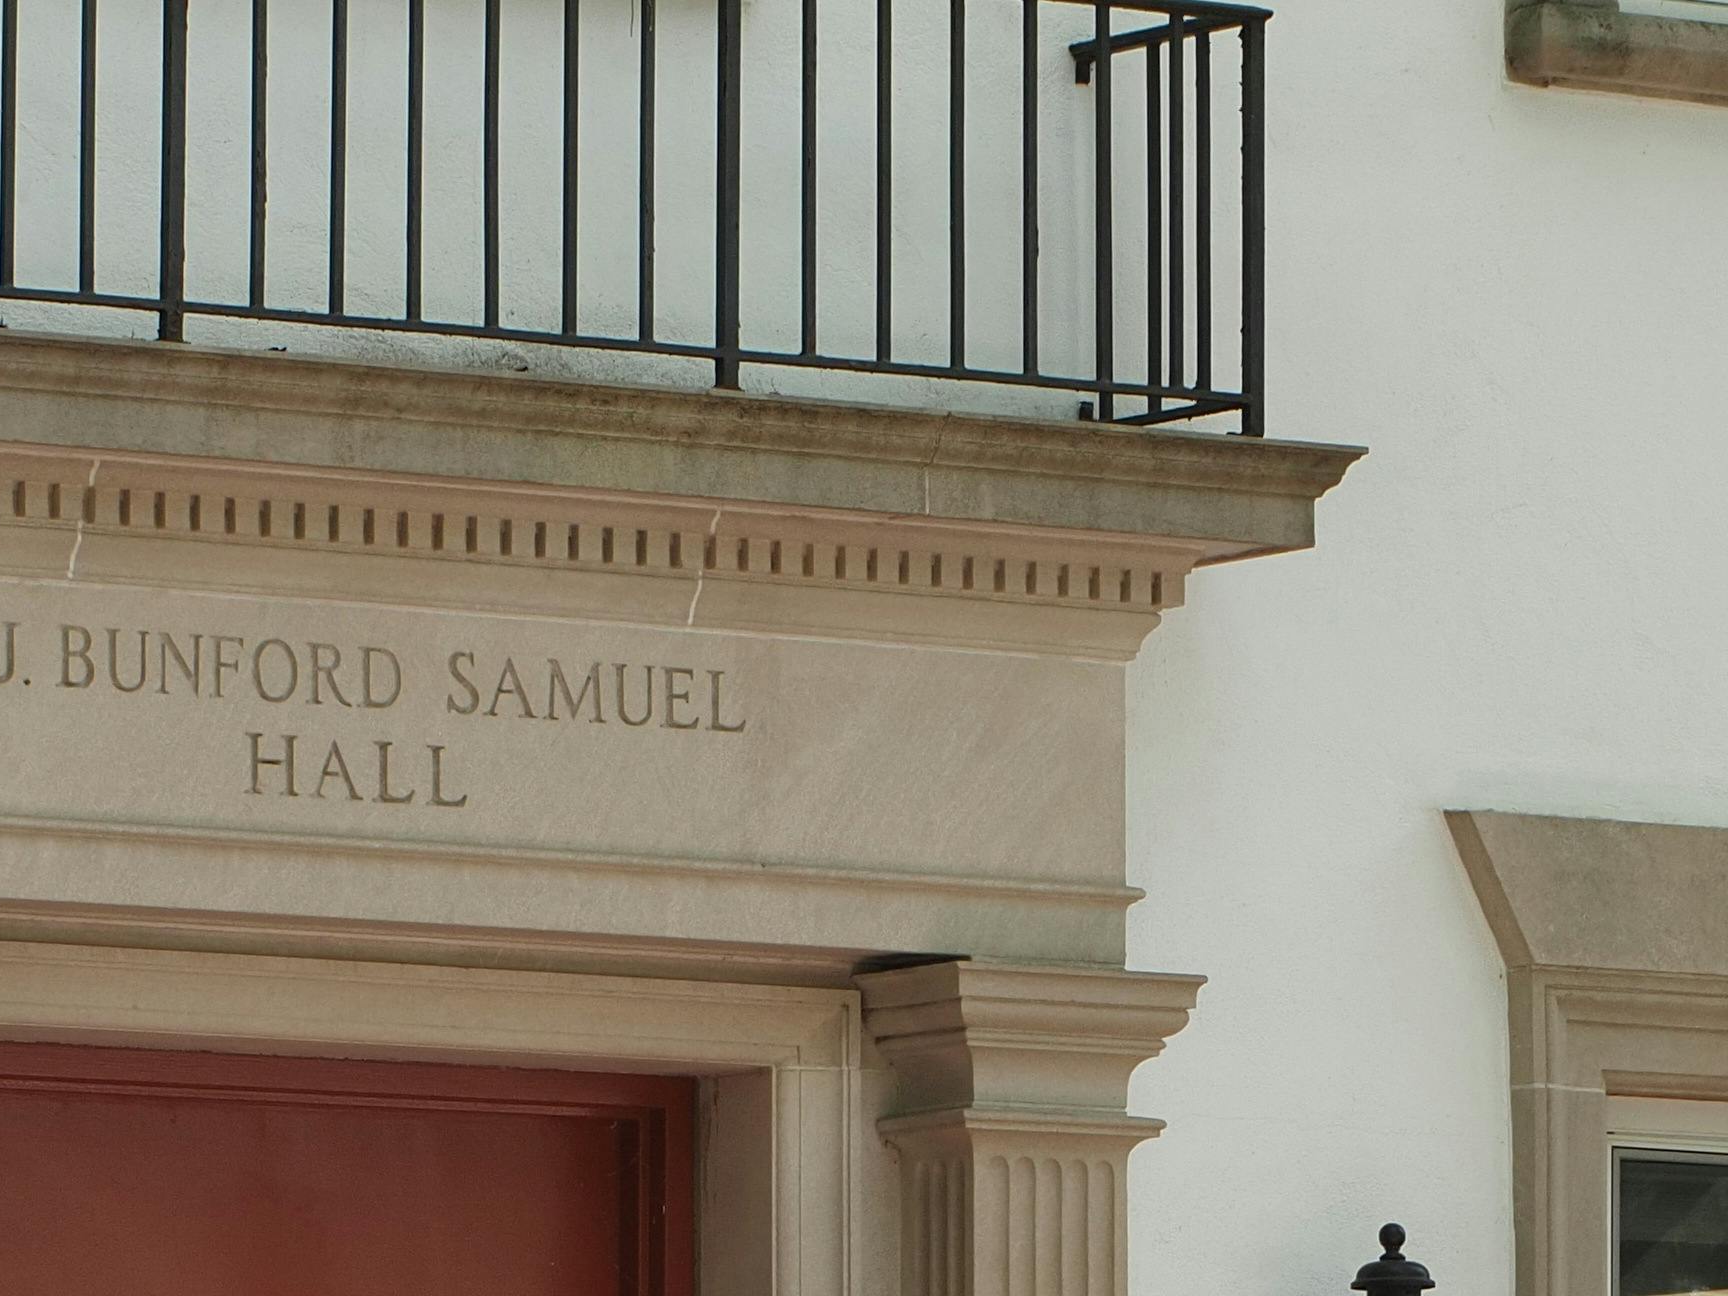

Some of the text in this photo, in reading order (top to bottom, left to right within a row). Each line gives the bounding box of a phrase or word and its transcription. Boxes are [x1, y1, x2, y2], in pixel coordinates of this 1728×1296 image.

[55, 624, 405, 710] BUNFORD
[445, 650, 747, 733] SAMUEL
[243, 732, 469, 807] HALL
